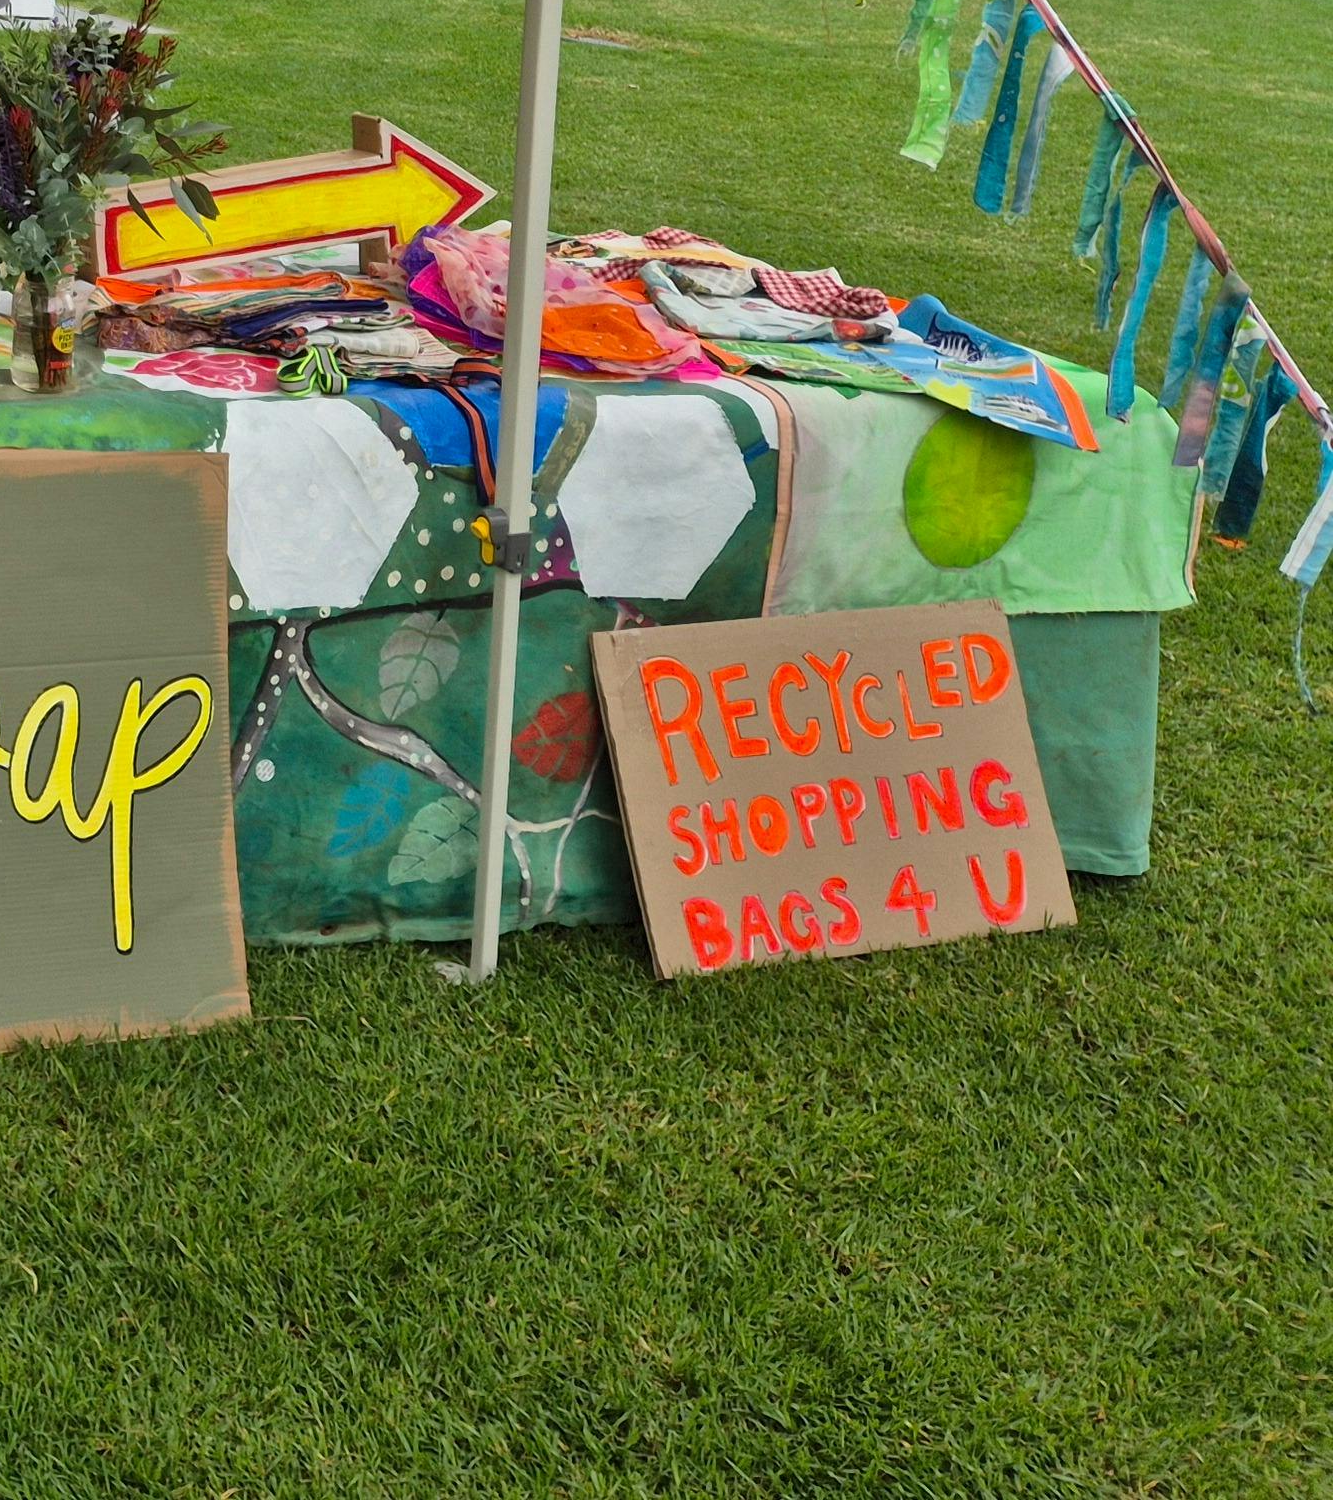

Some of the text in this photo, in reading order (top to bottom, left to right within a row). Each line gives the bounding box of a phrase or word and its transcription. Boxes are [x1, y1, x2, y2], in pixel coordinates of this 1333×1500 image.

[640, 632, 1013, 786] RECYCLED
[667, 758, 1030, 877] SHOPPING
[682, 848, 1030, 971] BAGS 4 U
